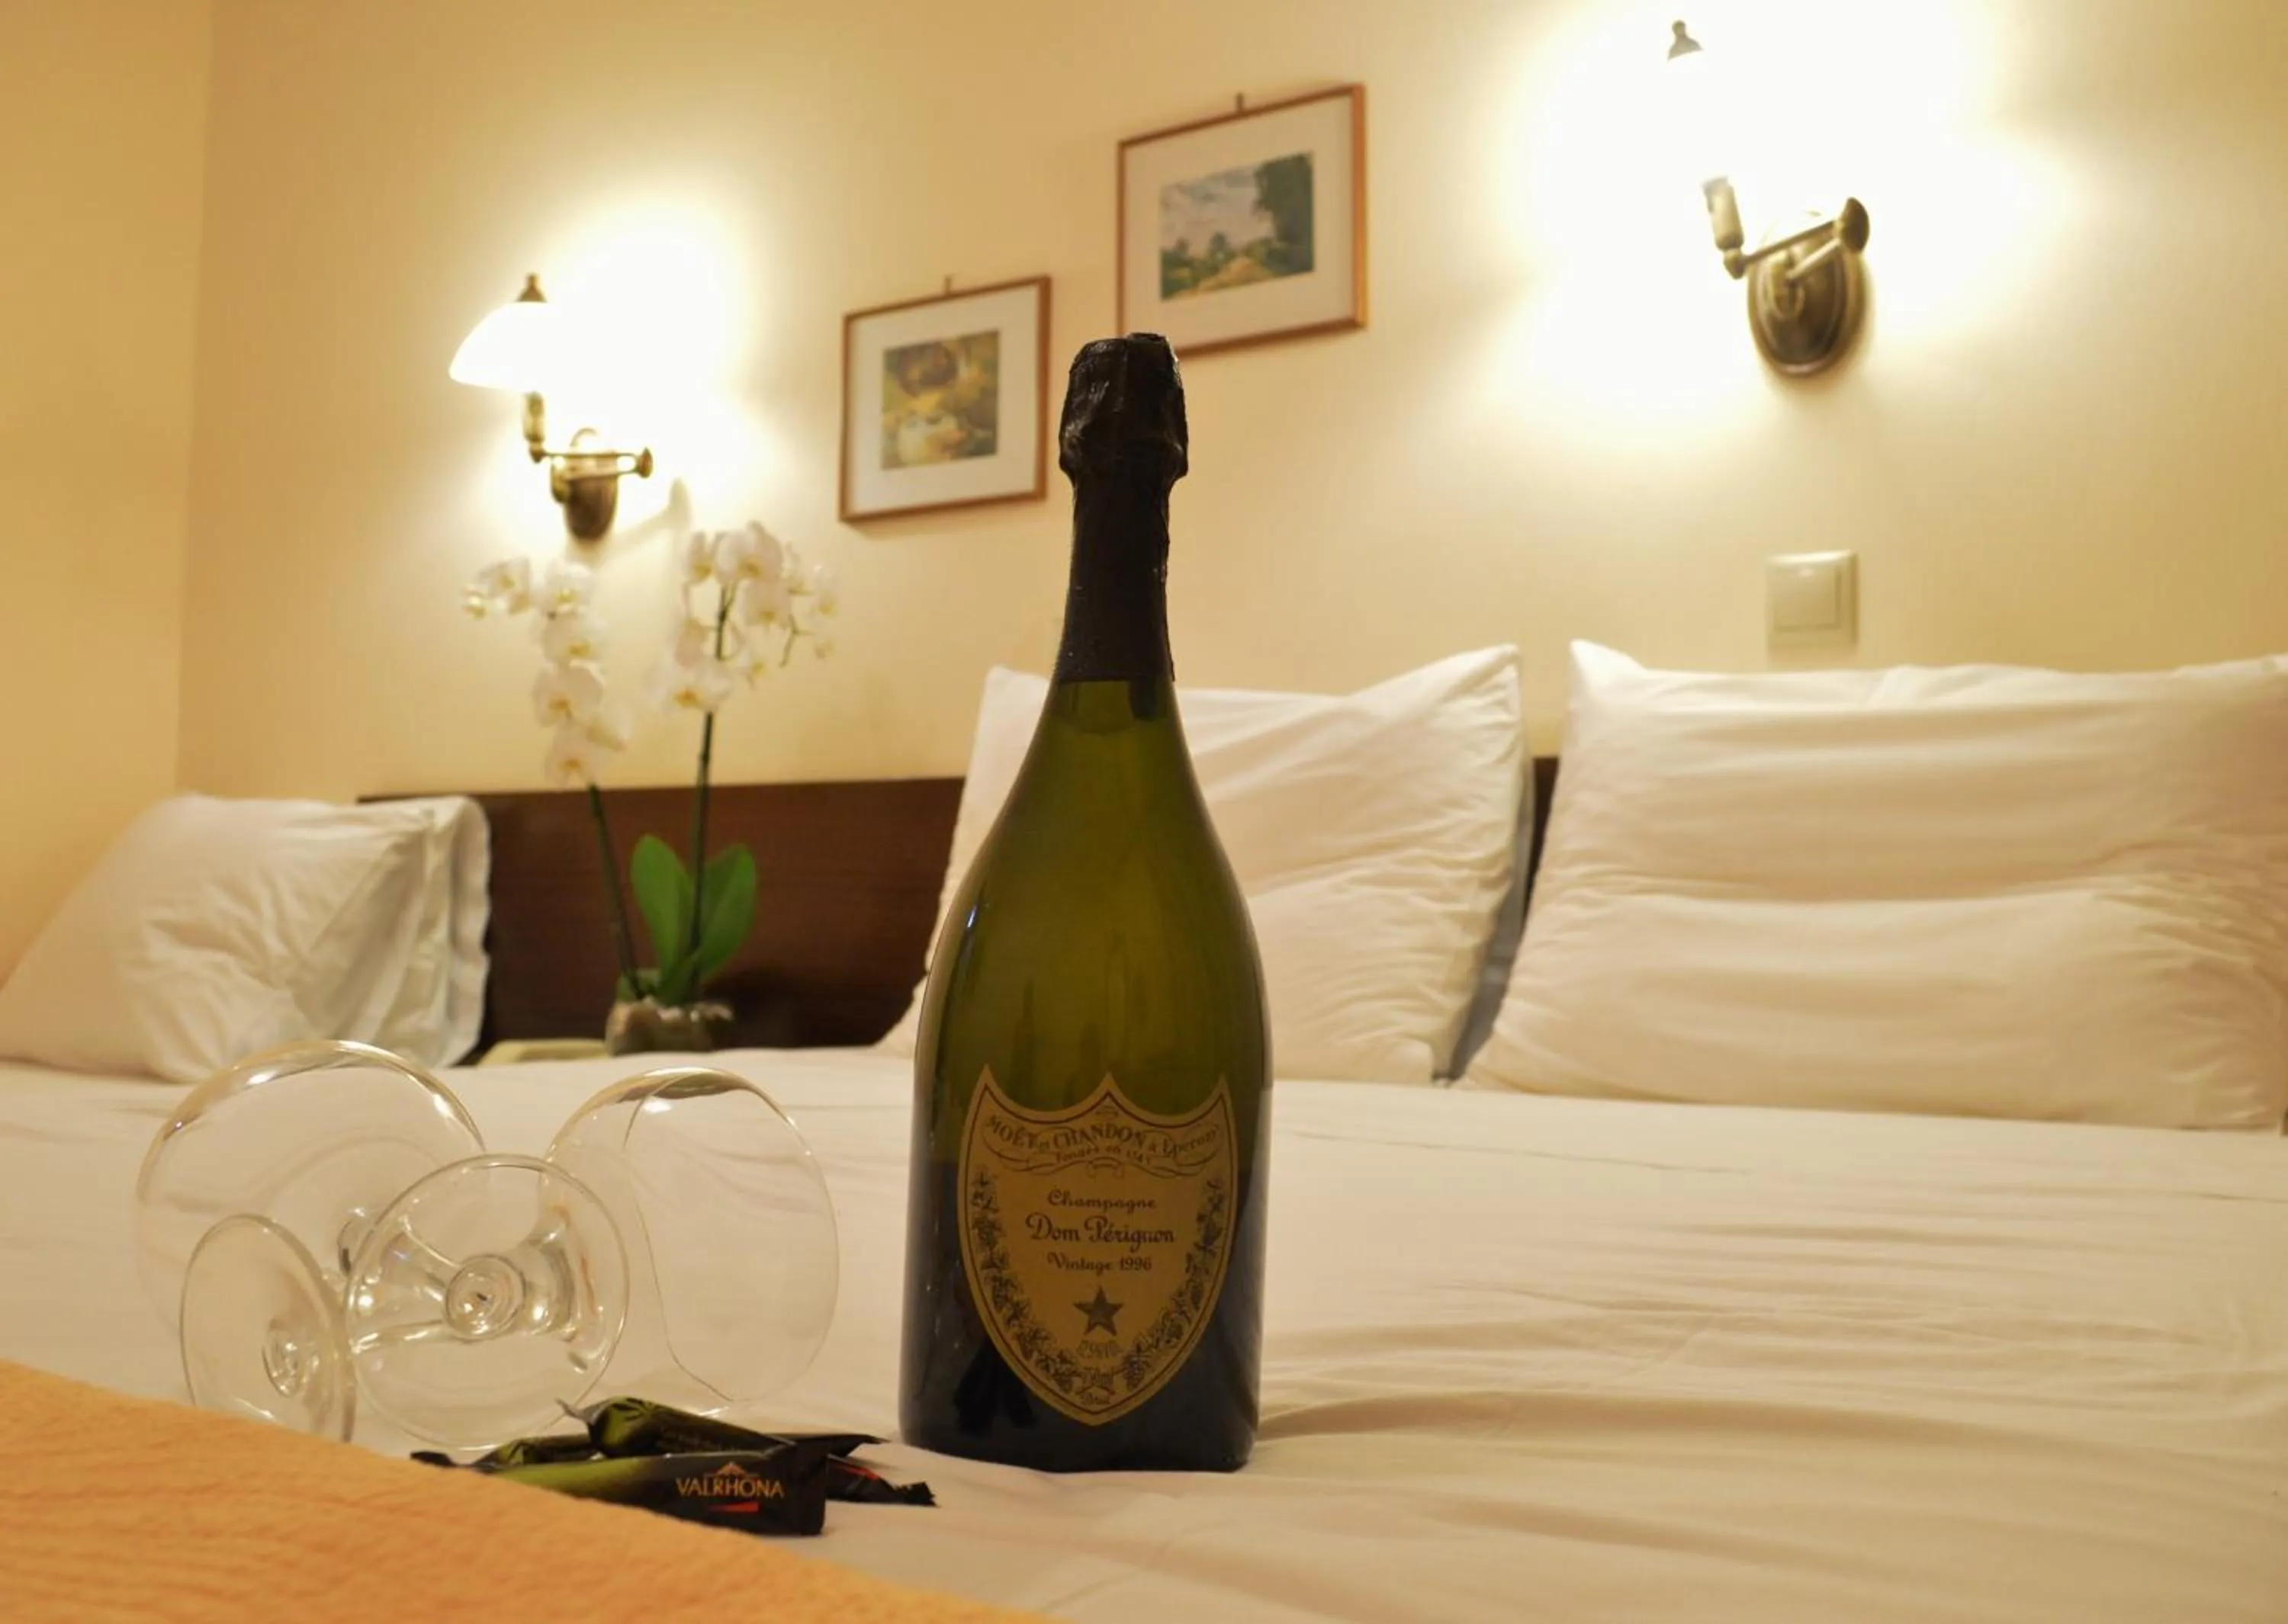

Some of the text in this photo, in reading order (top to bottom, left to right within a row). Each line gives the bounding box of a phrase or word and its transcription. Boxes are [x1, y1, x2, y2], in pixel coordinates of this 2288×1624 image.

[1053, 1123, 1148, 1149] CHANDON
[1048, 1187, 1156, 1214] Champagne
[1025, 1212, 1175, 1253] Dom Pérignon
[1047, 1252, 1111, 1276] Vintage
[675, 1478, 786, 1499] VALRHONA
